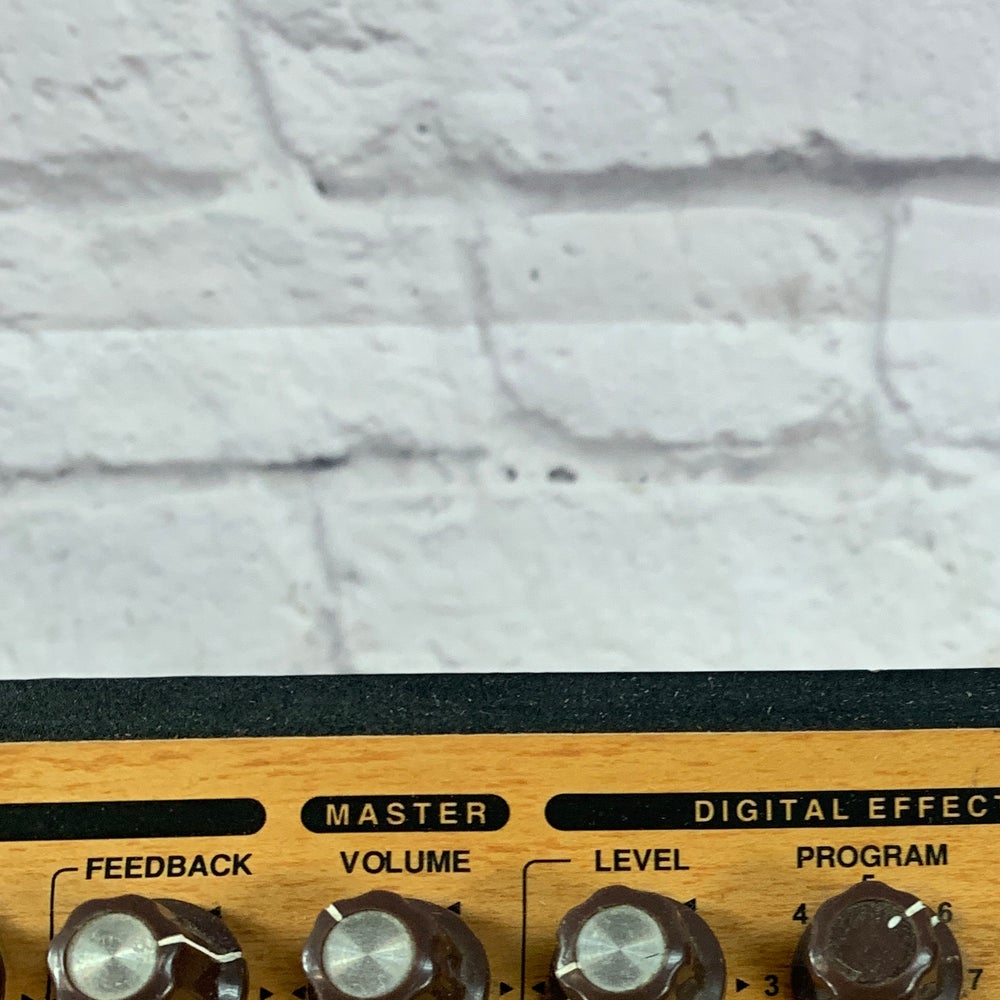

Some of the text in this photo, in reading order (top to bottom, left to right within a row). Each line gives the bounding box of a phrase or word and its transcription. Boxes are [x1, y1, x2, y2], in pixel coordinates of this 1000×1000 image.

[326, 801, 488, 826] MASTER
[695, 797, 849, 823] DIGITAL
[85, 853, 253, 879] FEEDBACK
[340, 850, 471, 874] VOLUME
[595, 849, 690, 871] LEVEL
[797, 844, 948, 868] PROGRAM
[792, 904, 807, 923] 4
[937, 902, 952, 923] 6
[764, 975, 779, 996] 3
[968, 969, 983, 989] 7
